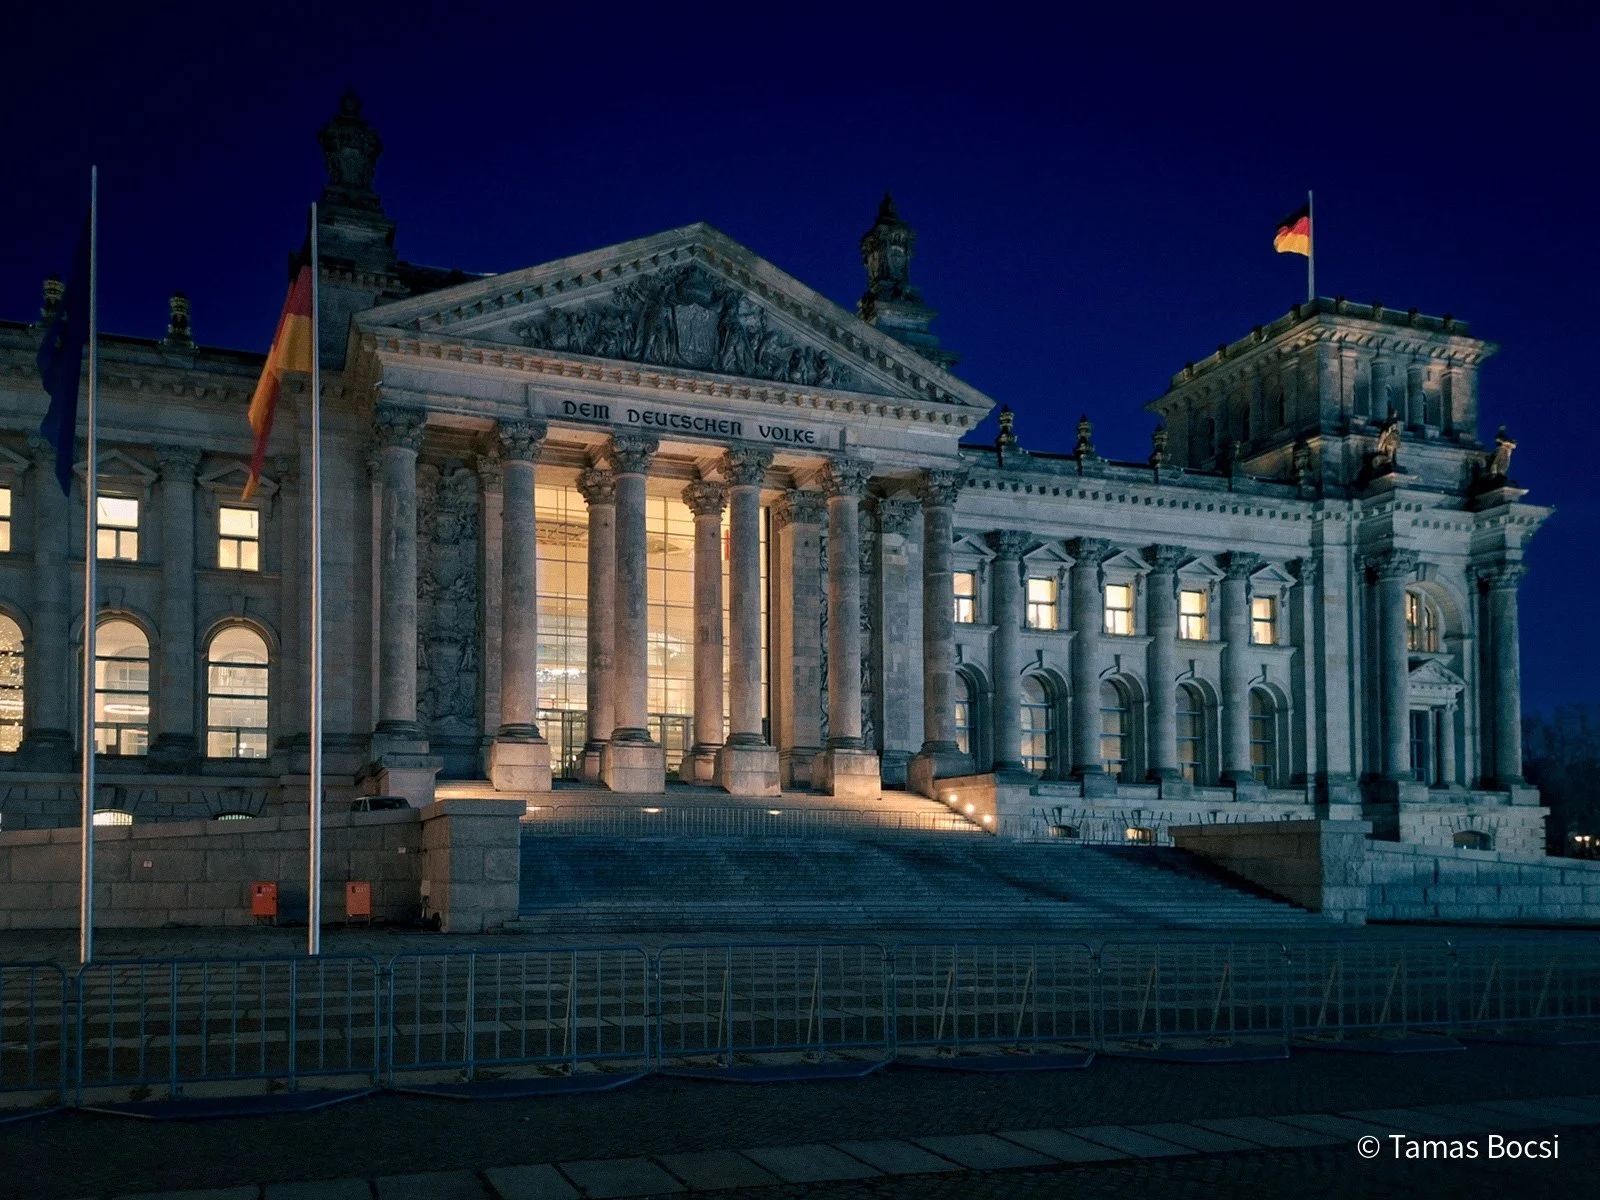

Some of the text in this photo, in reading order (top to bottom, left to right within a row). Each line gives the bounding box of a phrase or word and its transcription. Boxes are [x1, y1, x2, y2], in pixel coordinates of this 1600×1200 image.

[563, 400, 814, 443] DEM DEUTSCHEN VOLKE
